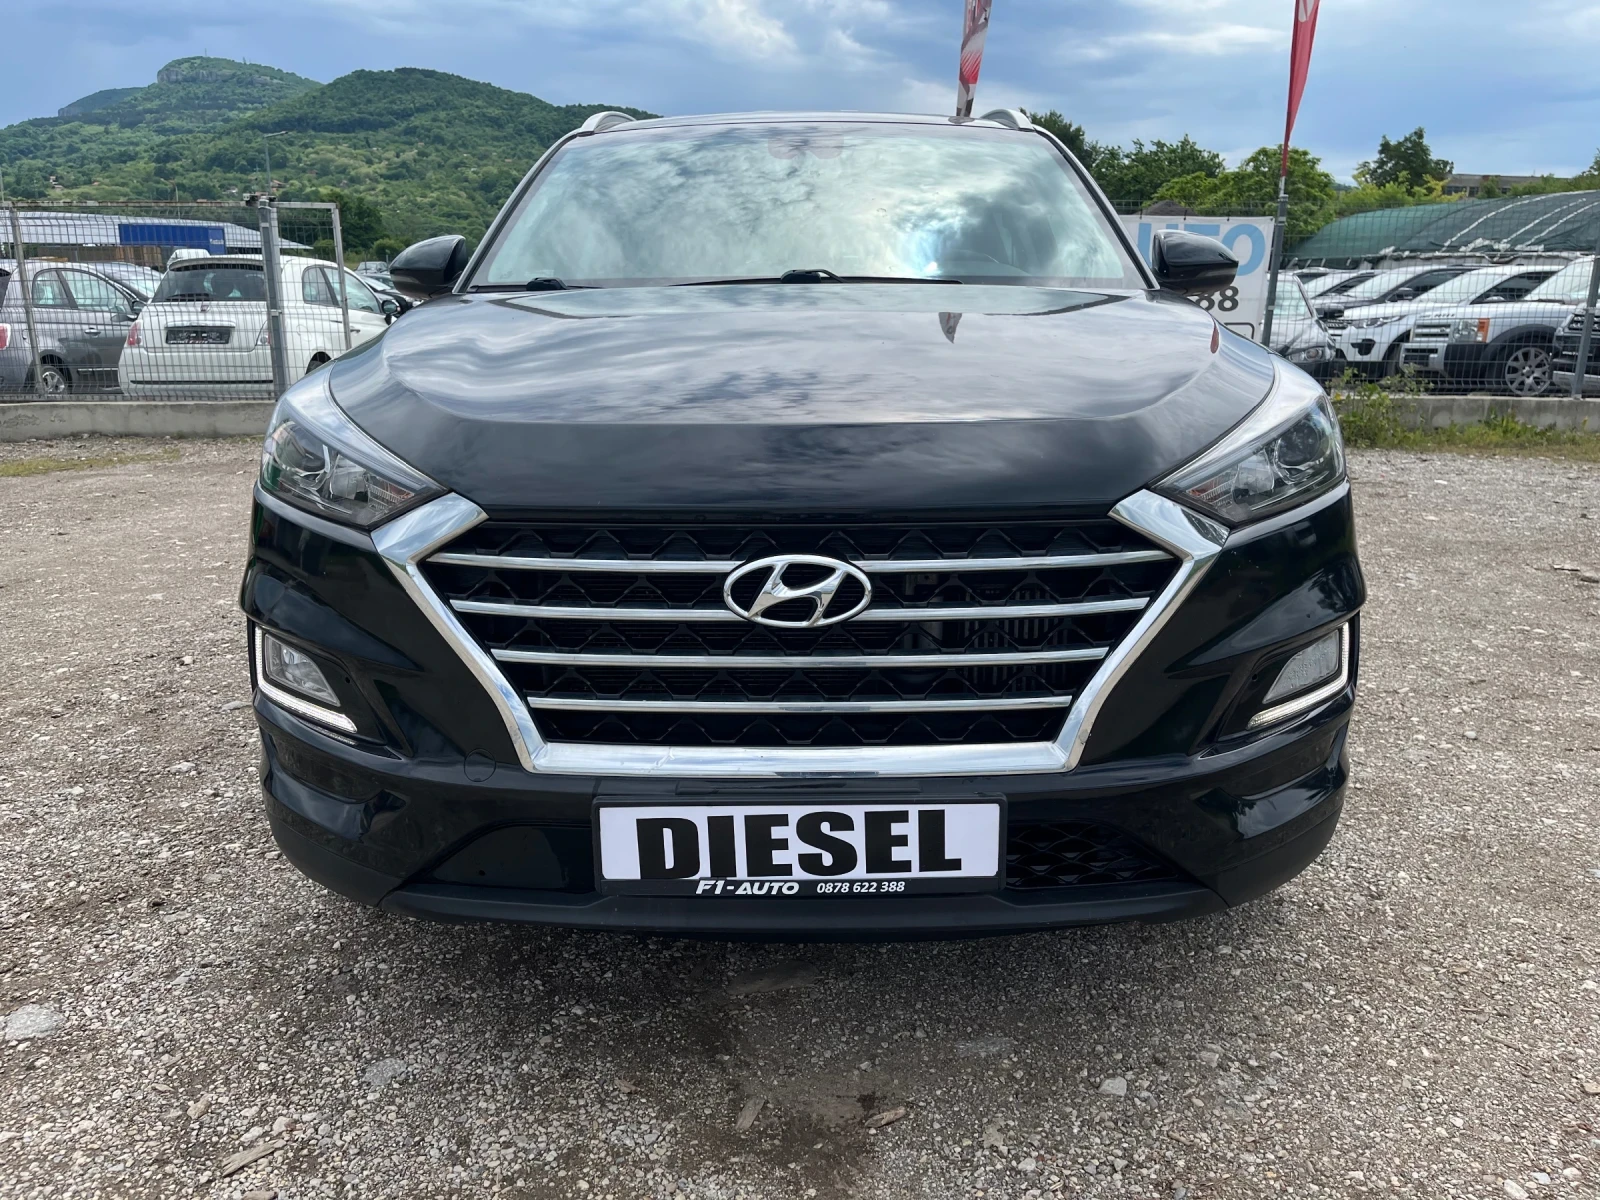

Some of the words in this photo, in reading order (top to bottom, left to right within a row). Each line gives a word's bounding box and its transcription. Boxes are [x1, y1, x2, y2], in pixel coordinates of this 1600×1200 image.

[636, 809, 962, 879] DIESEL
[696, 880, 799, 895] F1-AUTO
[816, 883, 850, 893] 0878
[853, 882, 877, 893] 622
[880, 881, 906, 892] 388
